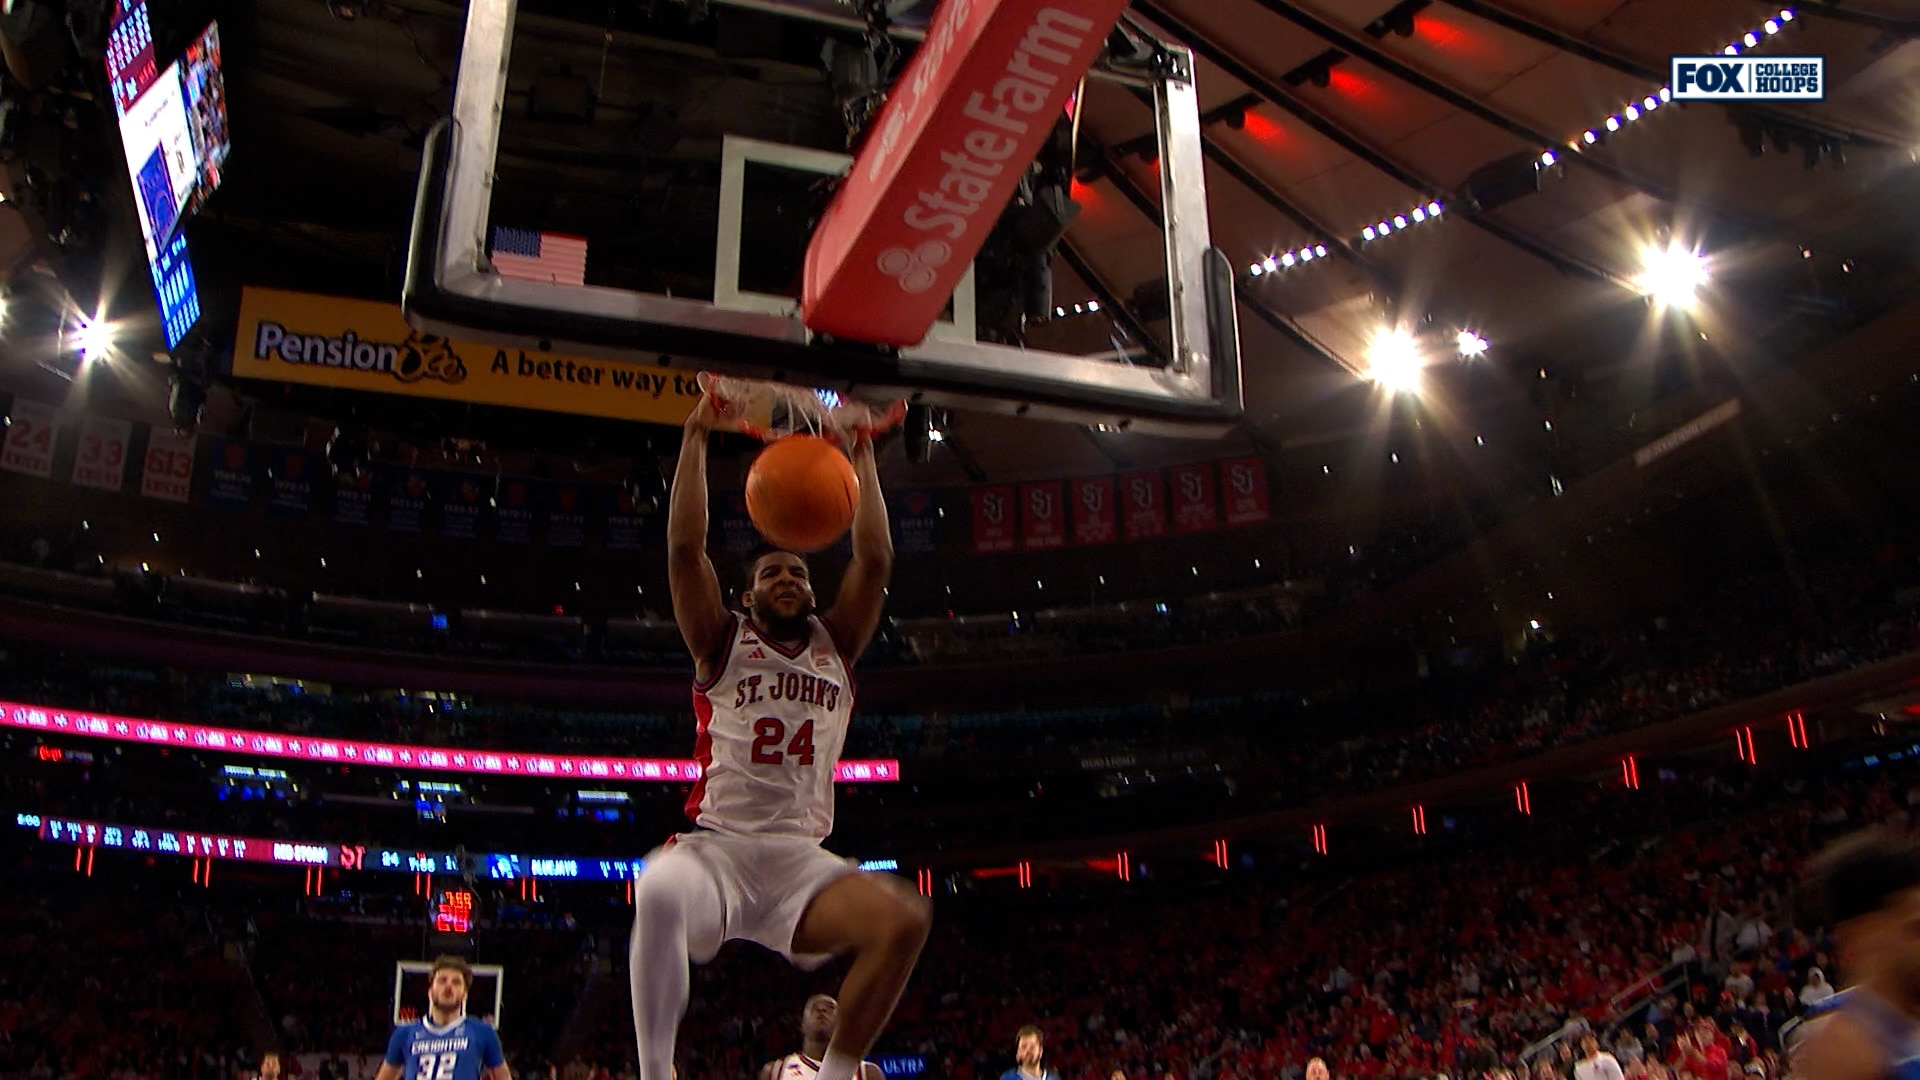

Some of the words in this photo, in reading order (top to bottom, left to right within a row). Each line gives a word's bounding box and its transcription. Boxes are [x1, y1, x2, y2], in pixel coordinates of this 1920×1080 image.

[490, 351, 509, 375] A
[517, 352, 604, 386] better
[612, 364, 667, 399] way
[10, 418, 52, 454] 24
[82, 431, 123, 467] 33
[146, 447, 192, 479] 613
[734, 674, 764, 710] ST.
[769, 671, 840, 712] JOHN'S
[751, 717, 815, 765] 24
[531, 859, 578, 877] BLUEJAYS
[411, 1037, 469, 1056] CREIGHTON
[416, 1052, 457, 1080] 32
[883, 1057, 926, 1074] ULTRA
